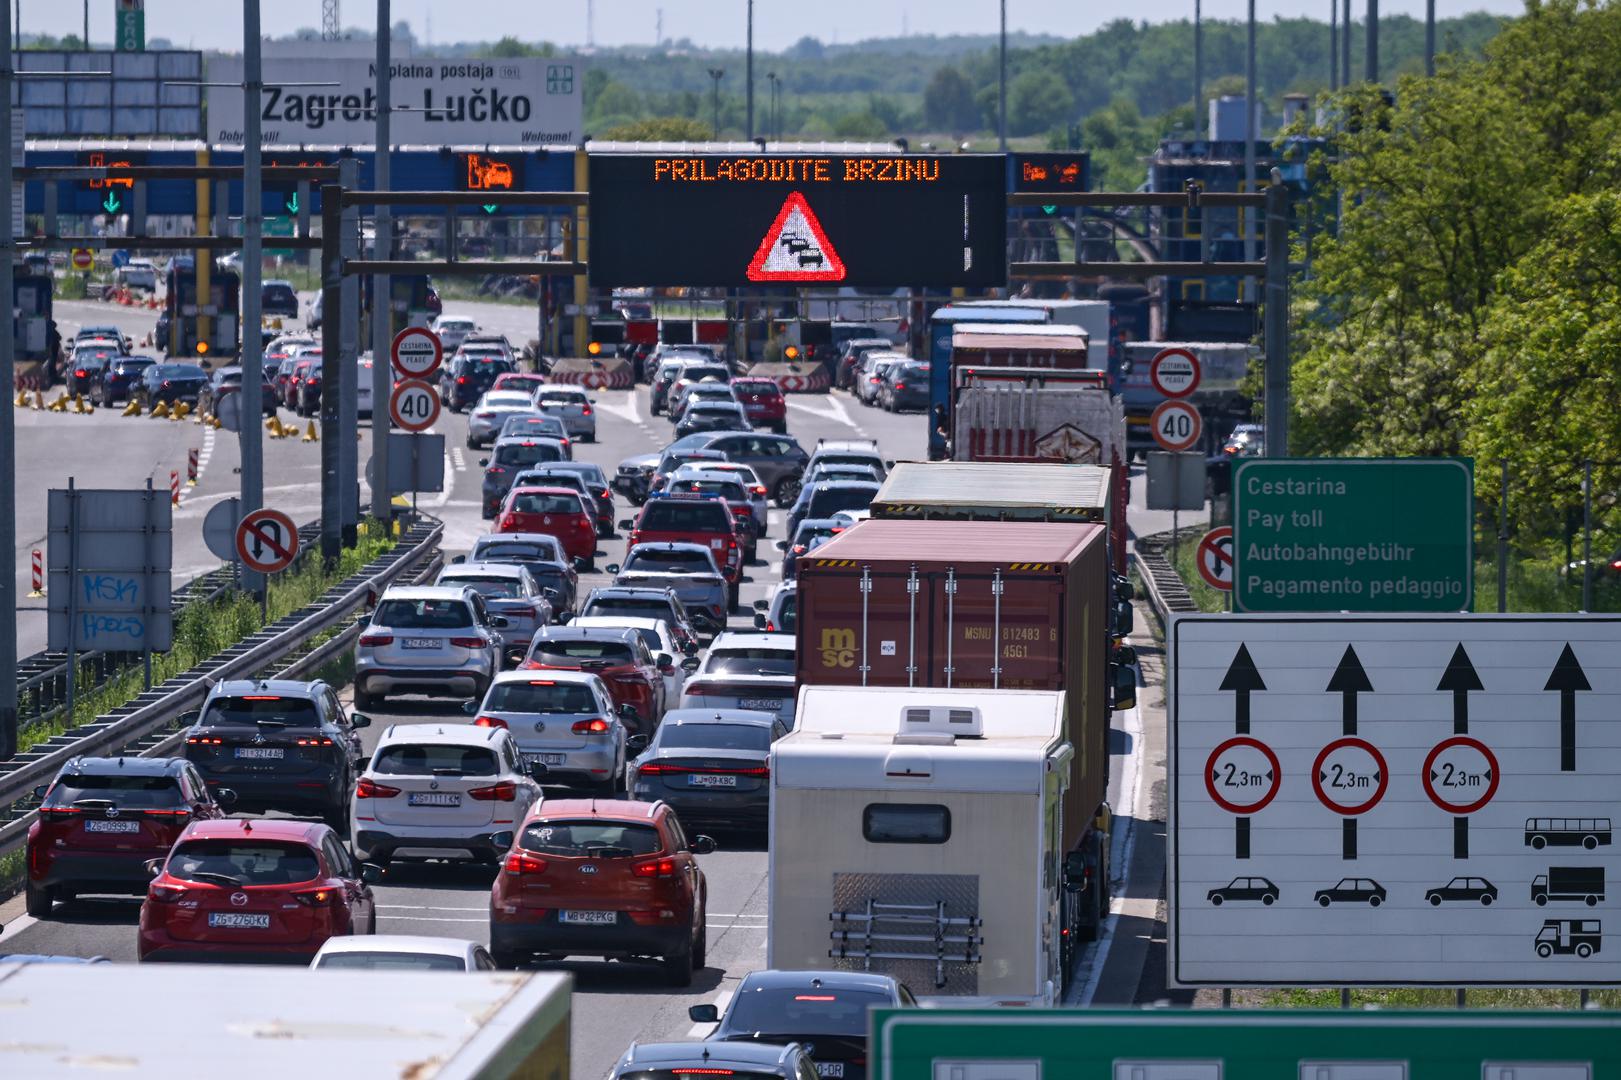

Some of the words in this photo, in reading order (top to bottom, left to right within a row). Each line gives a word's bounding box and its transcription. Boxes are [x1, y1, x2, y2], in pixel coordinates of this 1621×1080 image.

[369, 63, 433, 80] Nplatna
[440, 63, 494, 80] postaja
[262, 88, 377, 129] Zagreb
[424, 88, 531, 122] Lučko
[219, 130, 244, 141] Dobr
[521, 131, 572, 142] Welcome!
[654, 159, 831, 182] PRILAGODITE
[843, 159, 940, 182] BRZINU
[400, 342, 432, 350] CESTARINA
[401, 394, 429, 418] 40
[1162, 414, 1190, 438] 40
[1248, 477, 1346, 495] Cestarina
[1248, 509, 1284, 532] Pay
[1292, 509, 1323, 527] toll
[1247, 542, 1414, 565] Autobahngebühr
[1248, 576, 1363, 598] Pagamento
[1370, 576, 1462, 599] pedaggio
[964, 627, 991, 640] MSNU
[1002, 627, 1040, 641] 812483
[1049, 628, 1057, 641] 6
[1003, 645, 1028, 658] 45G1
